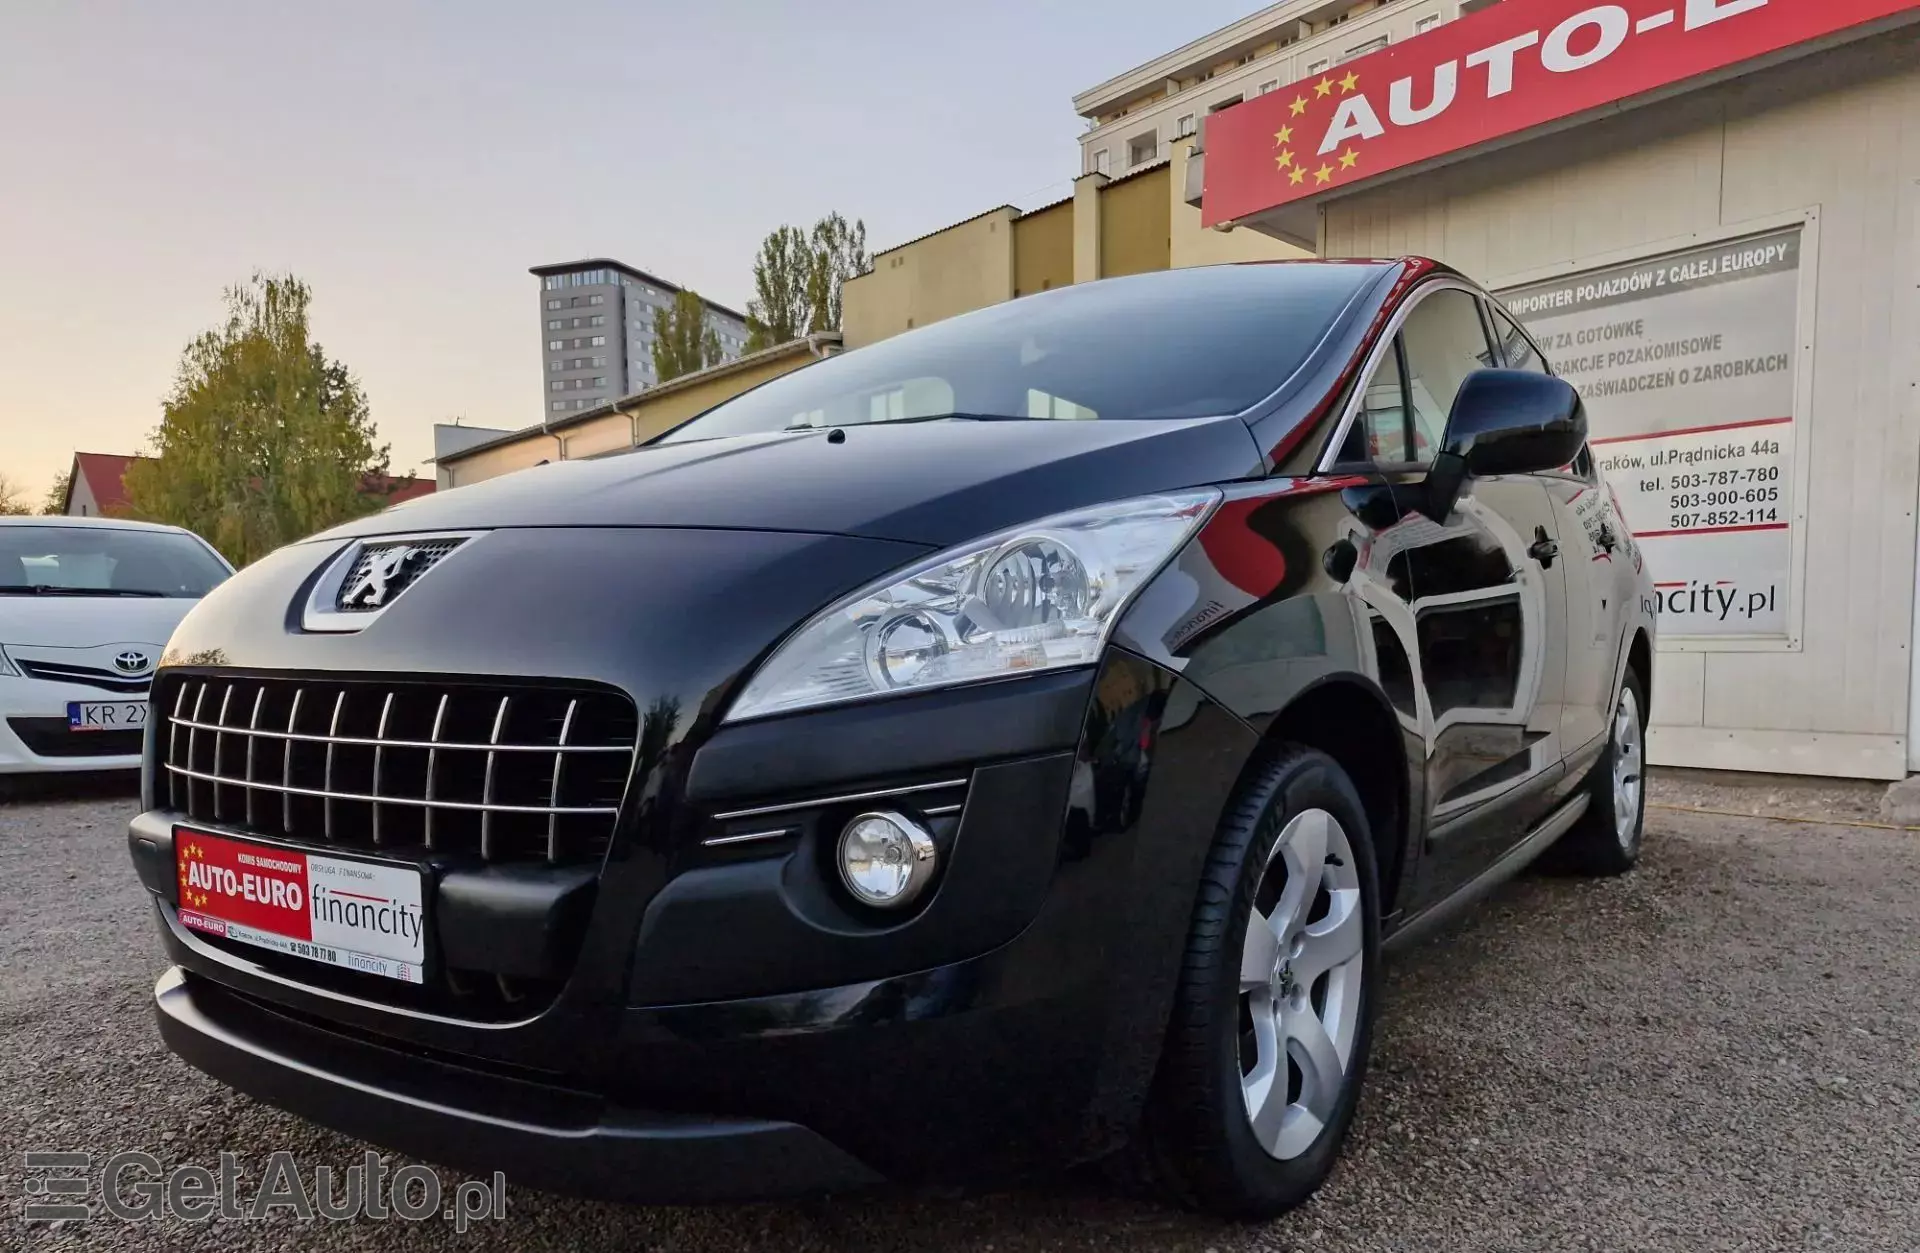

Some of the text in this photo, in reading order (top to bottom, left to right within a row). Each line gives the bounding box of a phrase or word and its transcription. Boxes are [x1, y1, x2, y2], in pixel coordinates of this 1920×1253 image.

[1508, 243, 1787, 316] IMPORTER POJAZDÓW Z CAŁEJ EUROPY
[1556, 332, 1573, 350] ZA
[1576, 319, 1644, 346] GOTÓWKĘ
[1550, 334, 1722, 376] SAKCJE POZAKOMISOWE
[1679, 368, 1689, 386] O
[1692, 353, 1788, 384] ZAROBKACH
[1599, 455, 1646, 472] raków,
[1751, 439, 1780, 456] 44a
[1640, 466, 1779, 492] tel. 503-787-780
[1670, 487, 1778, 509] 503-900-605
[1670, 508, 1778, 528] 507-852-114
[1655, 580, 1776, 621] ncity.pl
[86, 705, 116, 724] KR
[188, 861, 303, 911] AUTO-EURO
[182, 914, 225, 933] AUTO-EURO
[312, 883, 423, 948] financity
[298, 943, 310, 955] 503
[328, 949, 337, 962] 80
[348, 951, 388, 976] financity
